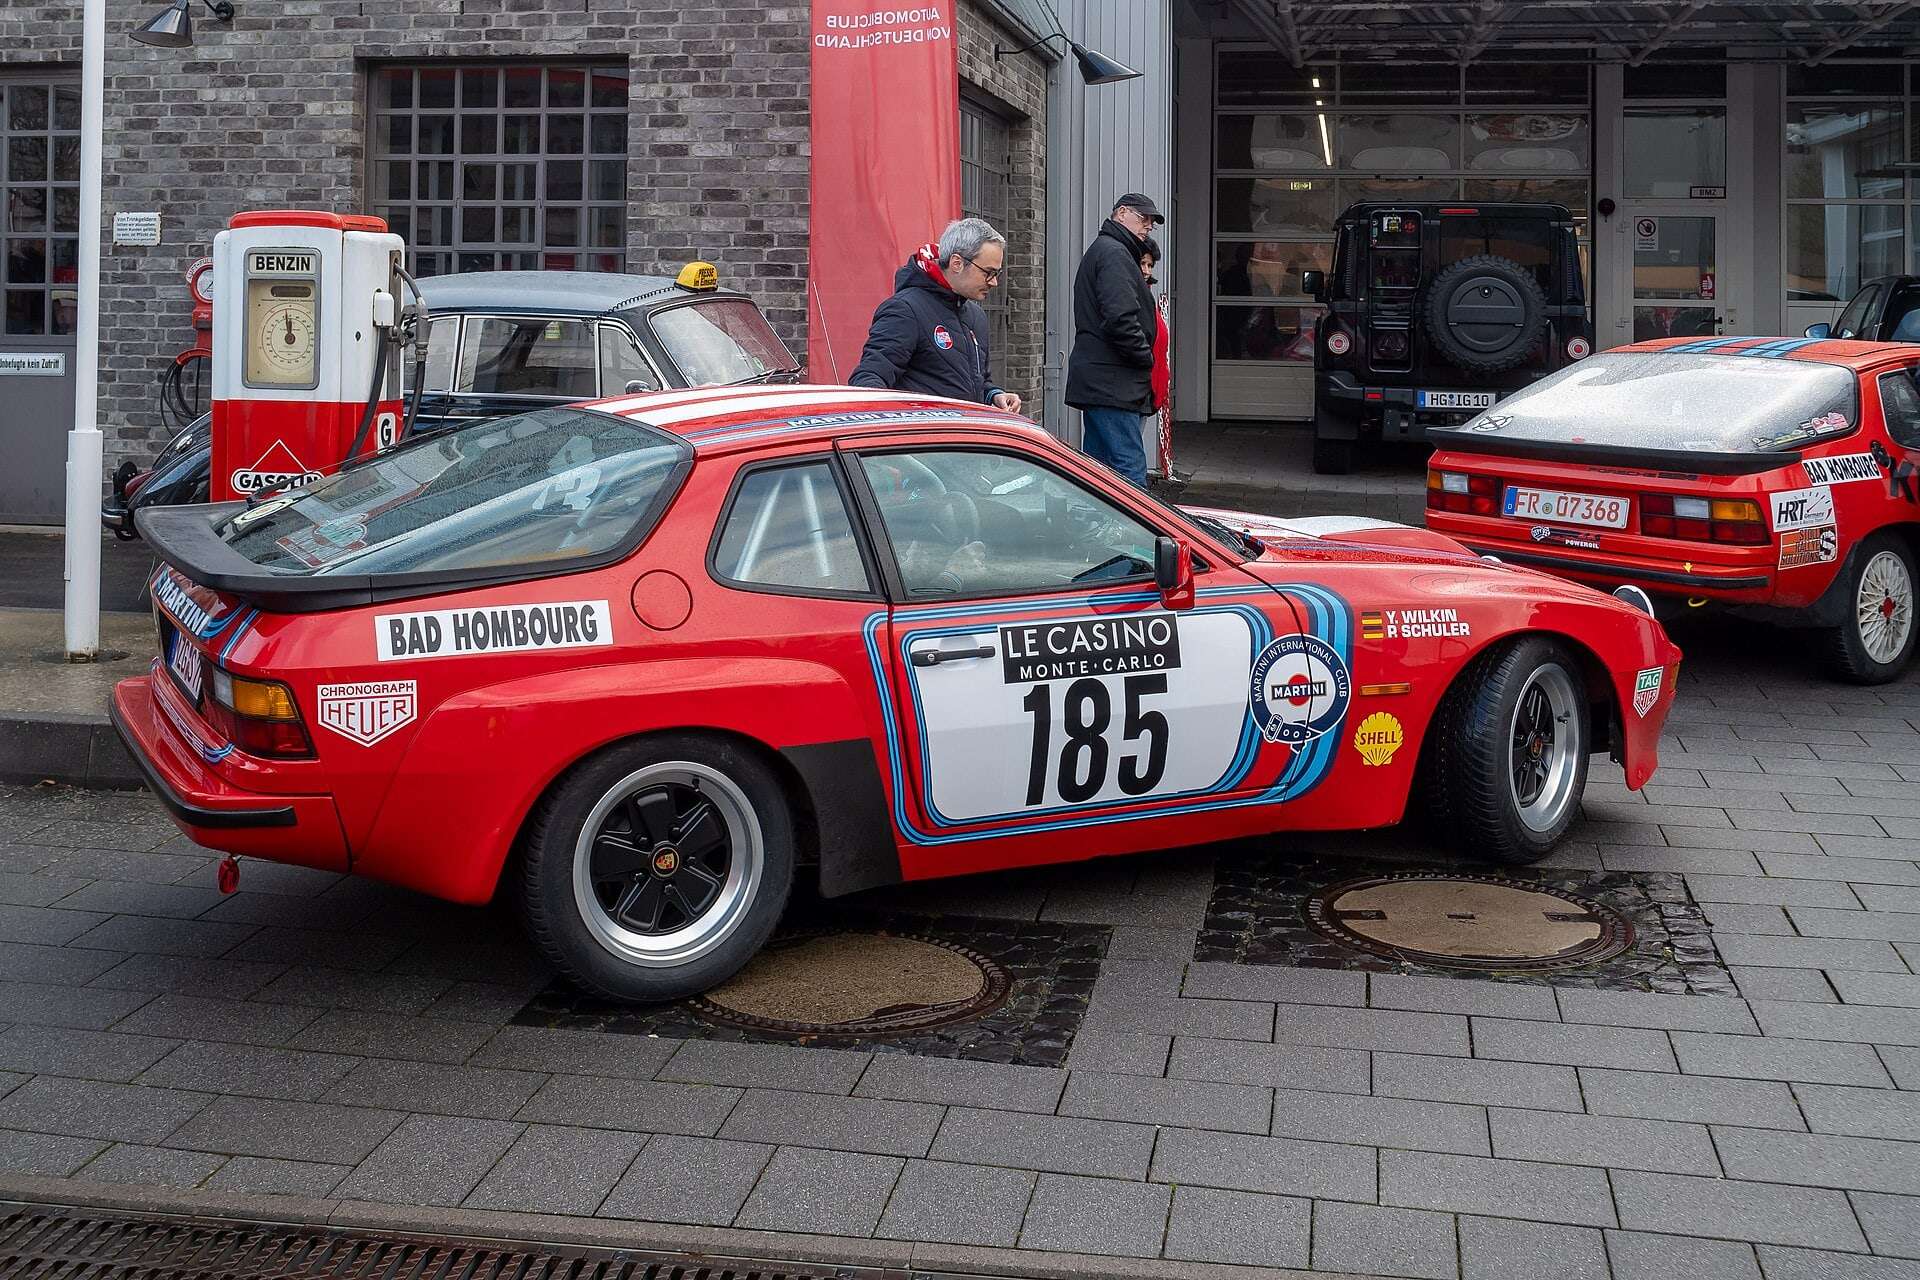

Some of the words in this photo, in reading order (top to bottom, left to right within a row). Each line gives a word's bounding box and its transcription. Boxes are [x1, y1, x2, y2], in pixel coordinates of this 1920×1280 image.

[255, 256, 311, 271] BENZIN
[27, 358, 40, 369] kein
[41, 358, 60, 369] Zutritt
[1430, 393, 1448, 406] HG
[1455, 394, 1471, 407] IG
[1473, 395, 1489, 407] 10
[787, 412, 883, 428] MARTINI
[885, 410, 961, 418] RACING
[380, 418, 392, 448] G
[1804, 460, 1827, 484] BAD
[1827, 453, 1881, 482] HOMBOURG
[1515, 491, 1540, 515] FR
[1556, 495, 1620, 523] 07368
[1565, 538, 1600, 550] POWEROIL
[158, 577, 210, 636] MARTINI
[1385, 610, 1399, 624] Y.
[1401, 608, 1458, 623] WILKIN
[389, 615, 442, 656] BAD
[452, 604, 598, 651] HOMBOURG
[1006, 628, 1039, 658] LE
[1047, 618, 1172, 655] CASINO
[1253, 656, 1269, 702] MARTINI
[1267, 640, 1333, 666] INTERNATIONAL
[1335, 669, 1347, 697] CLUB
[320, 682, 414, 697] CHRONOGRAPH
[1640, 673, 1660, 689] TAG
[1274, 683, 1324, 698] MARTINI
[328, 699, 407, 737] HEUER
[1023, 673, 1169, 806] 185
[1359, 731, 1397, 745] SHELL
